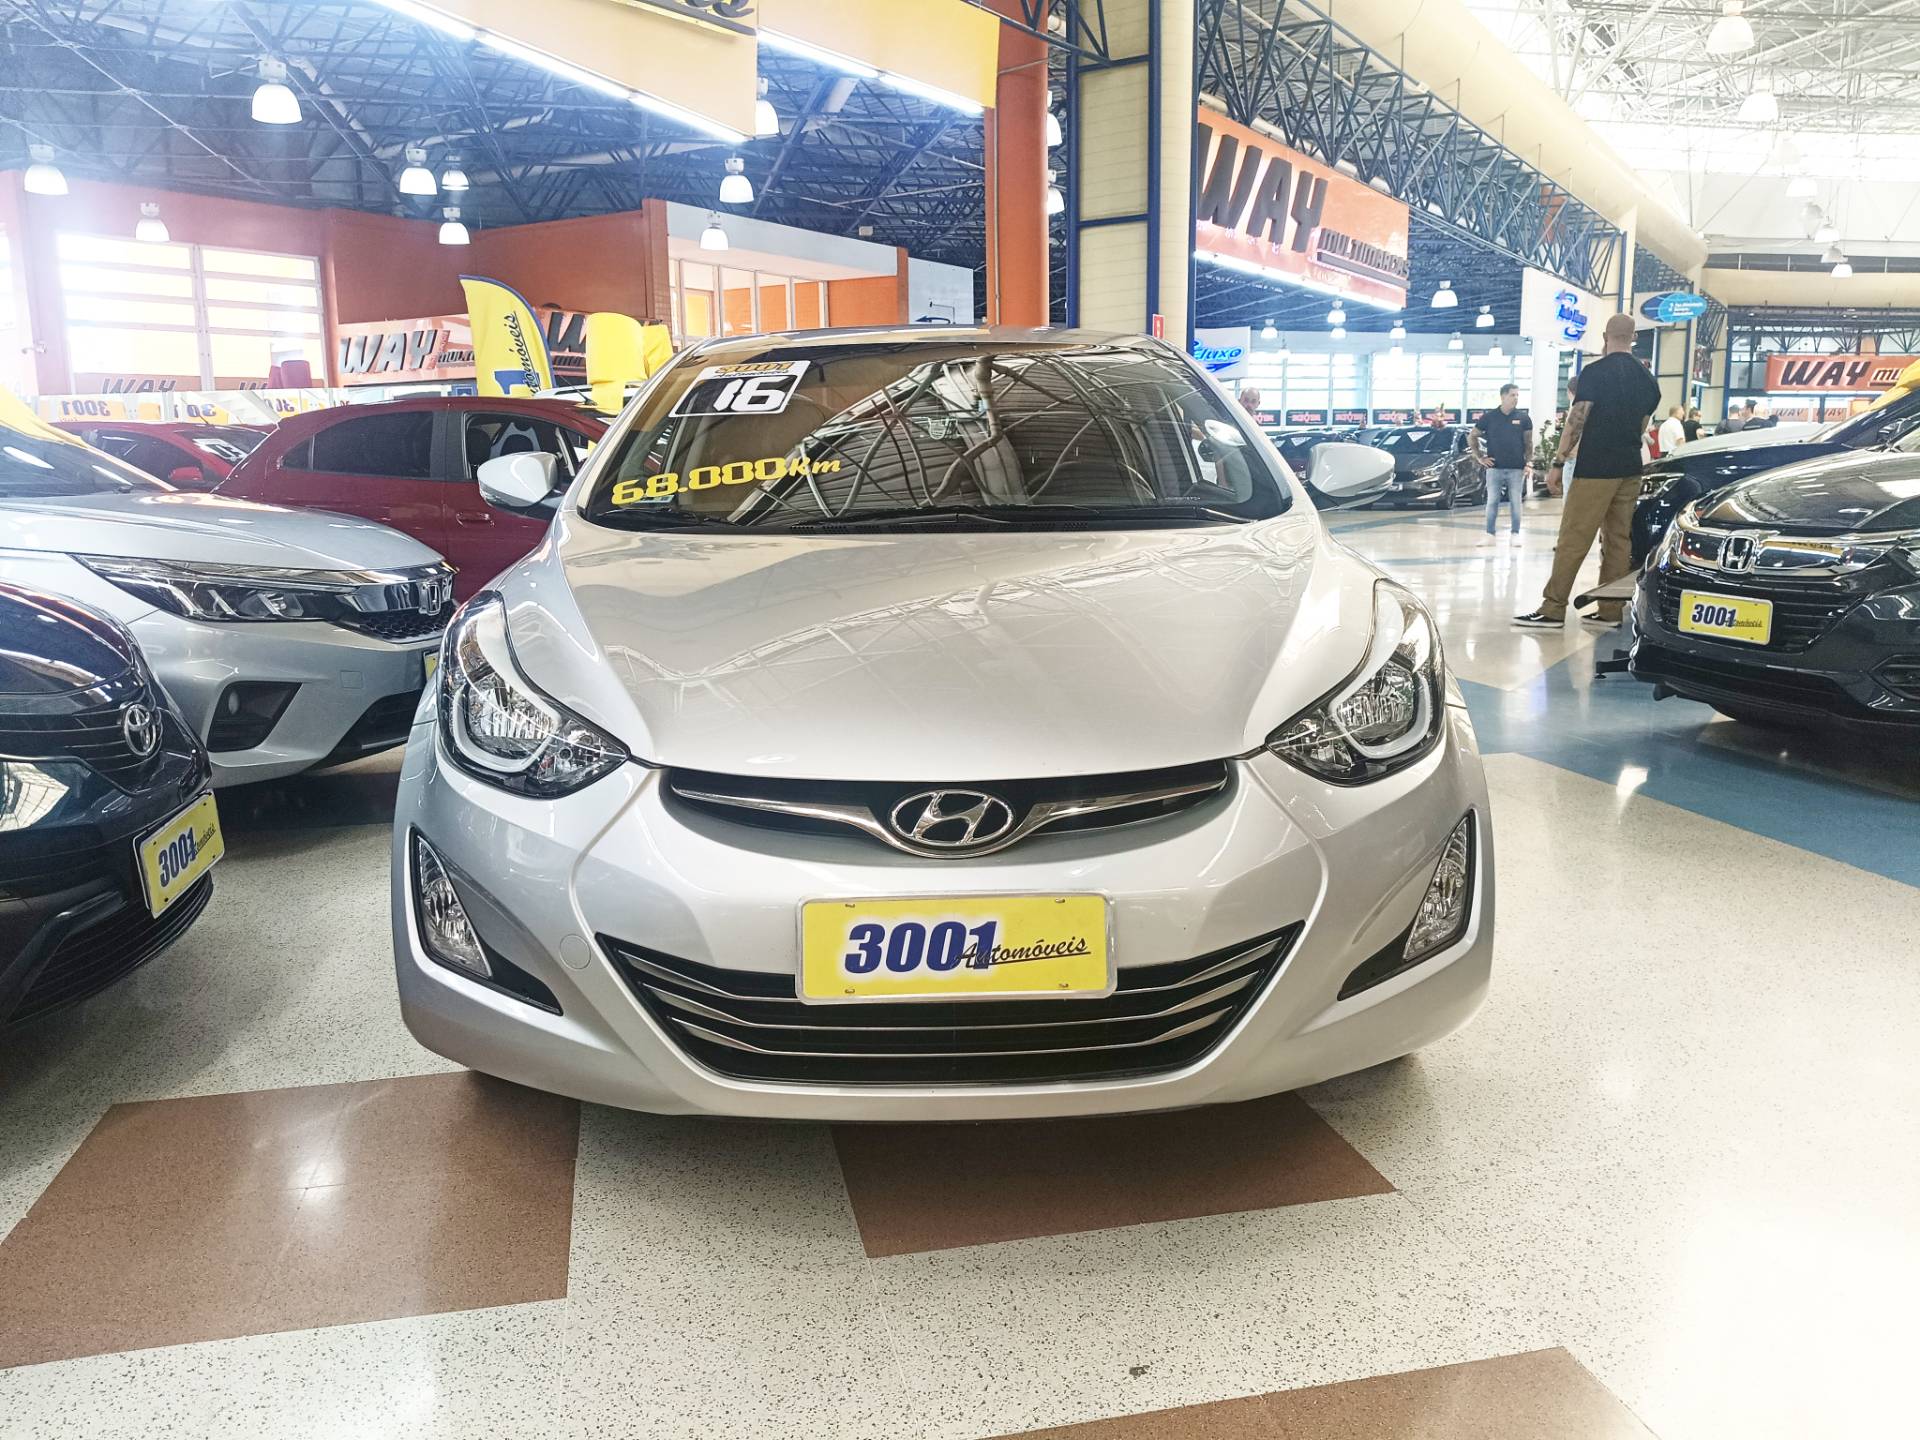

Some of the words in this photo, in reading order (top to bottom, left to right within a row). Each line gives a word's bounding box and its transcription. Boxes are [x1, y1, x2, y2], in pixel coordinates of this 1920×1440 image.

[1197, 122, 1328, 253] WAY
[341, 329, 438, 373] WAY
[713, 376, 790, 411] 16
[1780, 361, 1870, 386] WAY
[1691, 603, 1737, 628] 3001
[158, 827, 197, 888] 3001
[844, 921, 998, 974] 3001
[951, 936, 1091, 969] Automóveis
